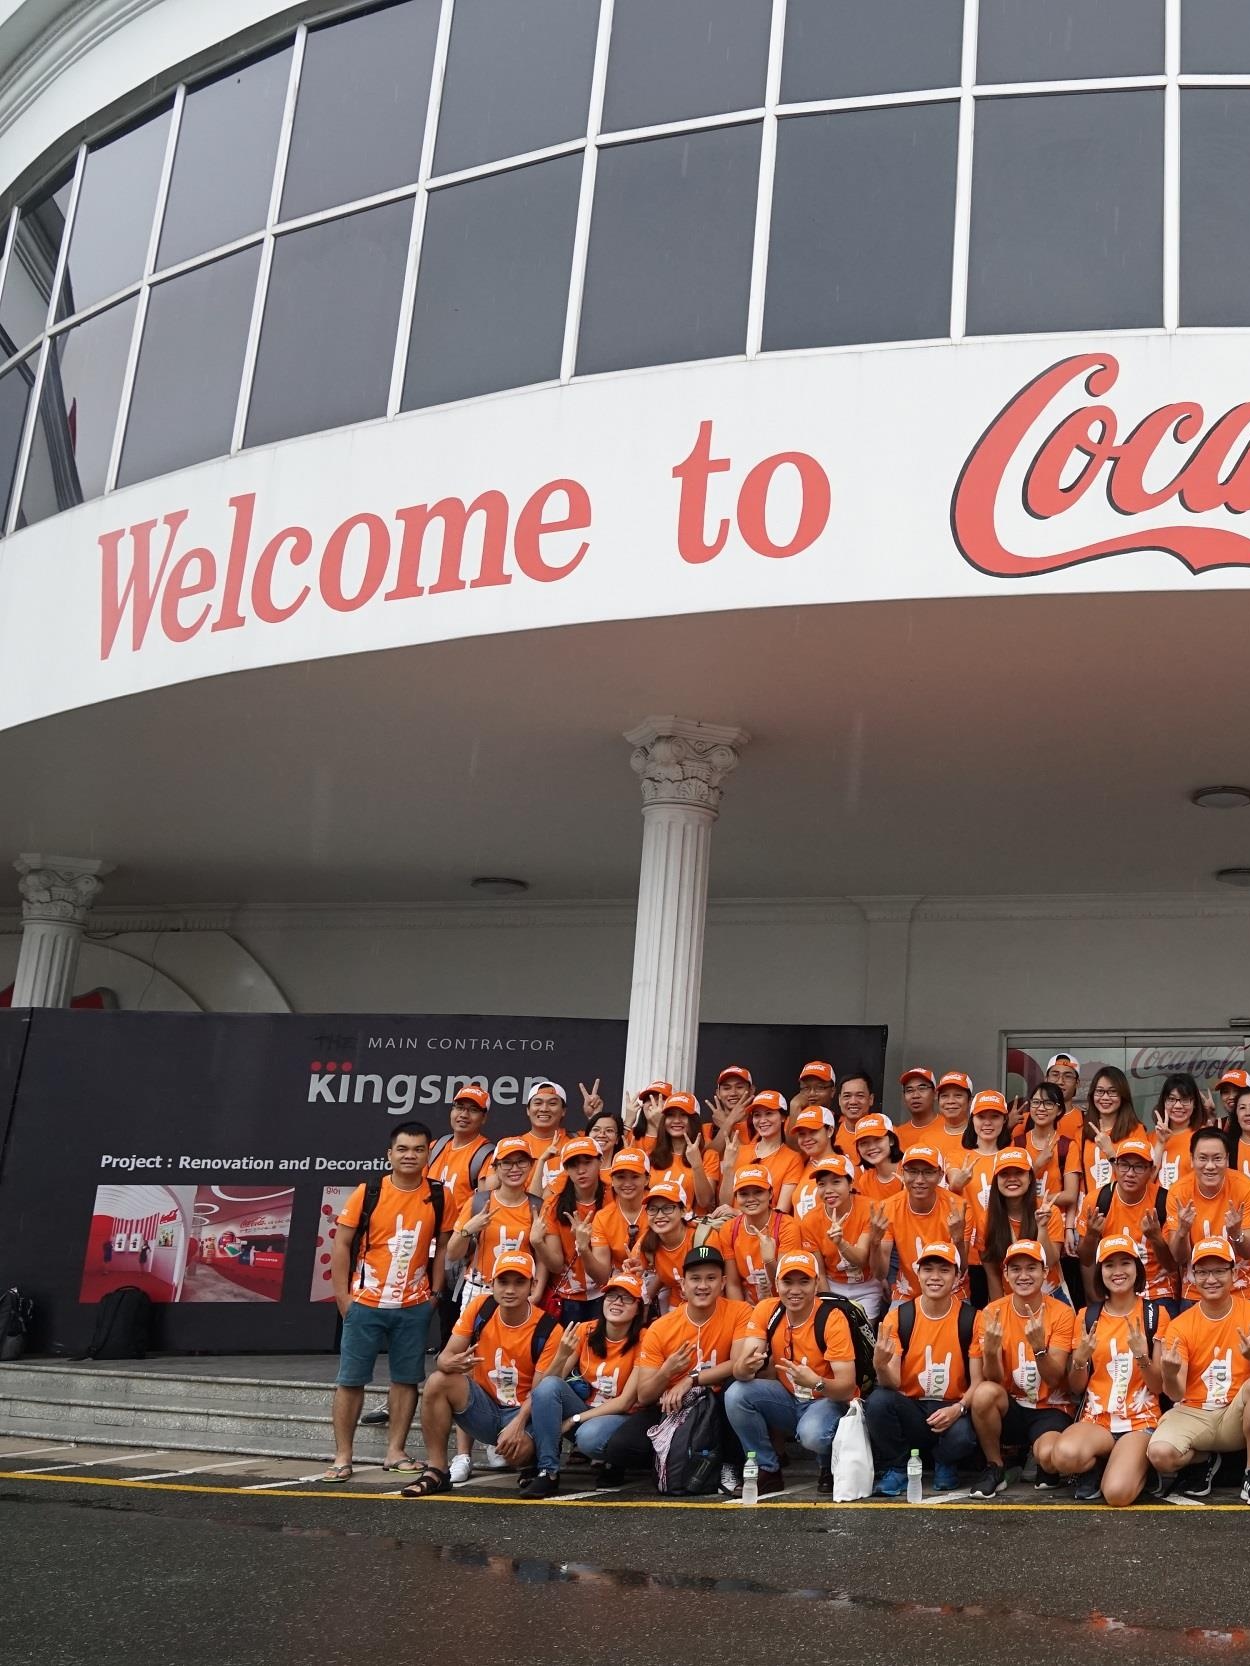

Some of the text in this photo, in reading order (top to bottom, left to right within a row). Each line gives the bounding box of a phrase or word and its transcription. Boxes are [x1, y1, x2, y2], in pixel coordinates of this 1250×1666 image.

[98, 477, 592, 661] Welcome
[671, 419, 832, 565] to
[368, 1037, 418, 1049] MAIN
[427, 1038, 555, 1052] CONTRACTOR
[100, 1150, 163, 1171] Project
[178, 1156, 274, 1170] Renovation
[279, 1157, 310, 1170] and
[315, 1157, 393, 1171] Decoratio
